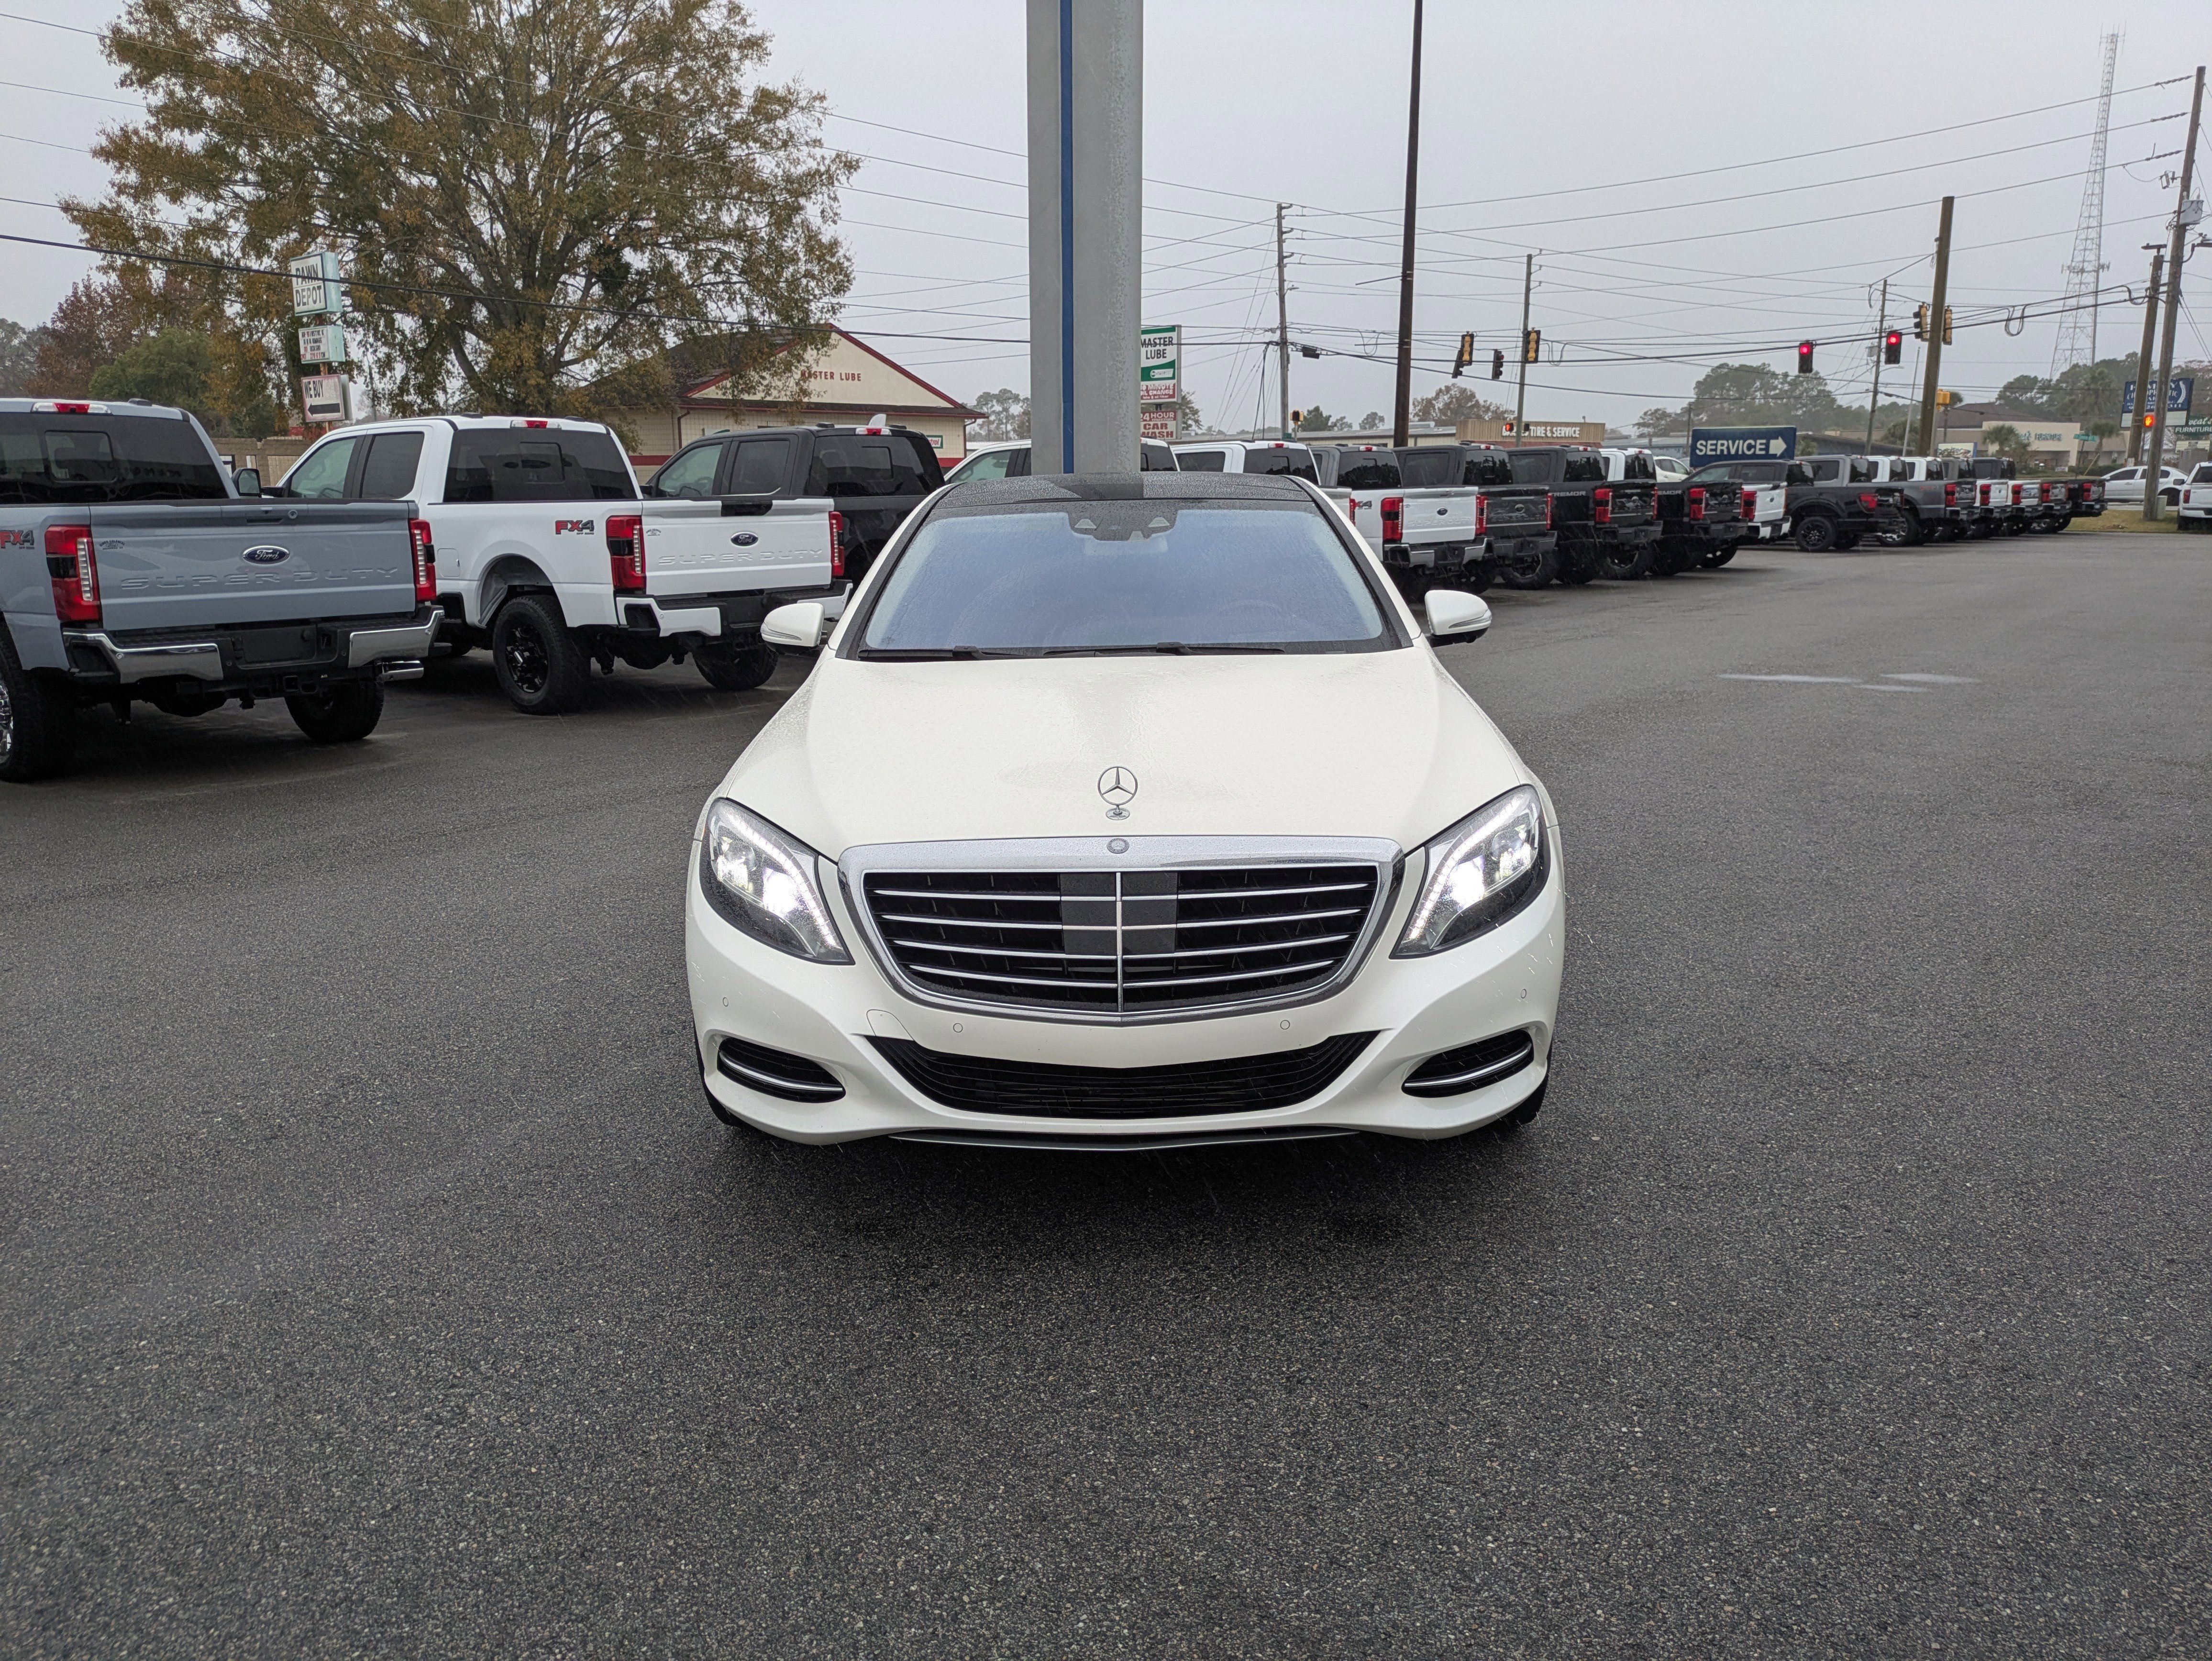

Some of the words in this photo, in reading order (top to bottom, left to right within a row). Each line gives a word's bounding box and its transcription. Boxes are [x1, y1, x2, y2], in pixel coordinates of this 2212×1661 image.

[295, 264, 319, 286] PAWN
[295, 285, 322, 307] DEPOT
[1141, 336, 1173, 348] MASTER
[1146, 349, 1167, 360] LUBE
[840, 372, 861, 381] LUBE
[303, 380, 312, 399] WE
[312, 379, 323, 398] BUY
[1531, 426, 1545, 436] TIRE
[1547, 427, 1551, 437] &
[1552, 427, 1580, 437] SERVICE
[1696, 439, 1767, 455] SERVICE
[555, 520, 594, 534] FX4
[0, 530, 34, 549] FX4
[255, 550, 279, 560] Ford
[659, 553, 752, 565] SUPER
[760, 549, 822, 560] DUTY
[122, 572, 280, 589] SUPER
[293, 567, 398, 582] DUTY
